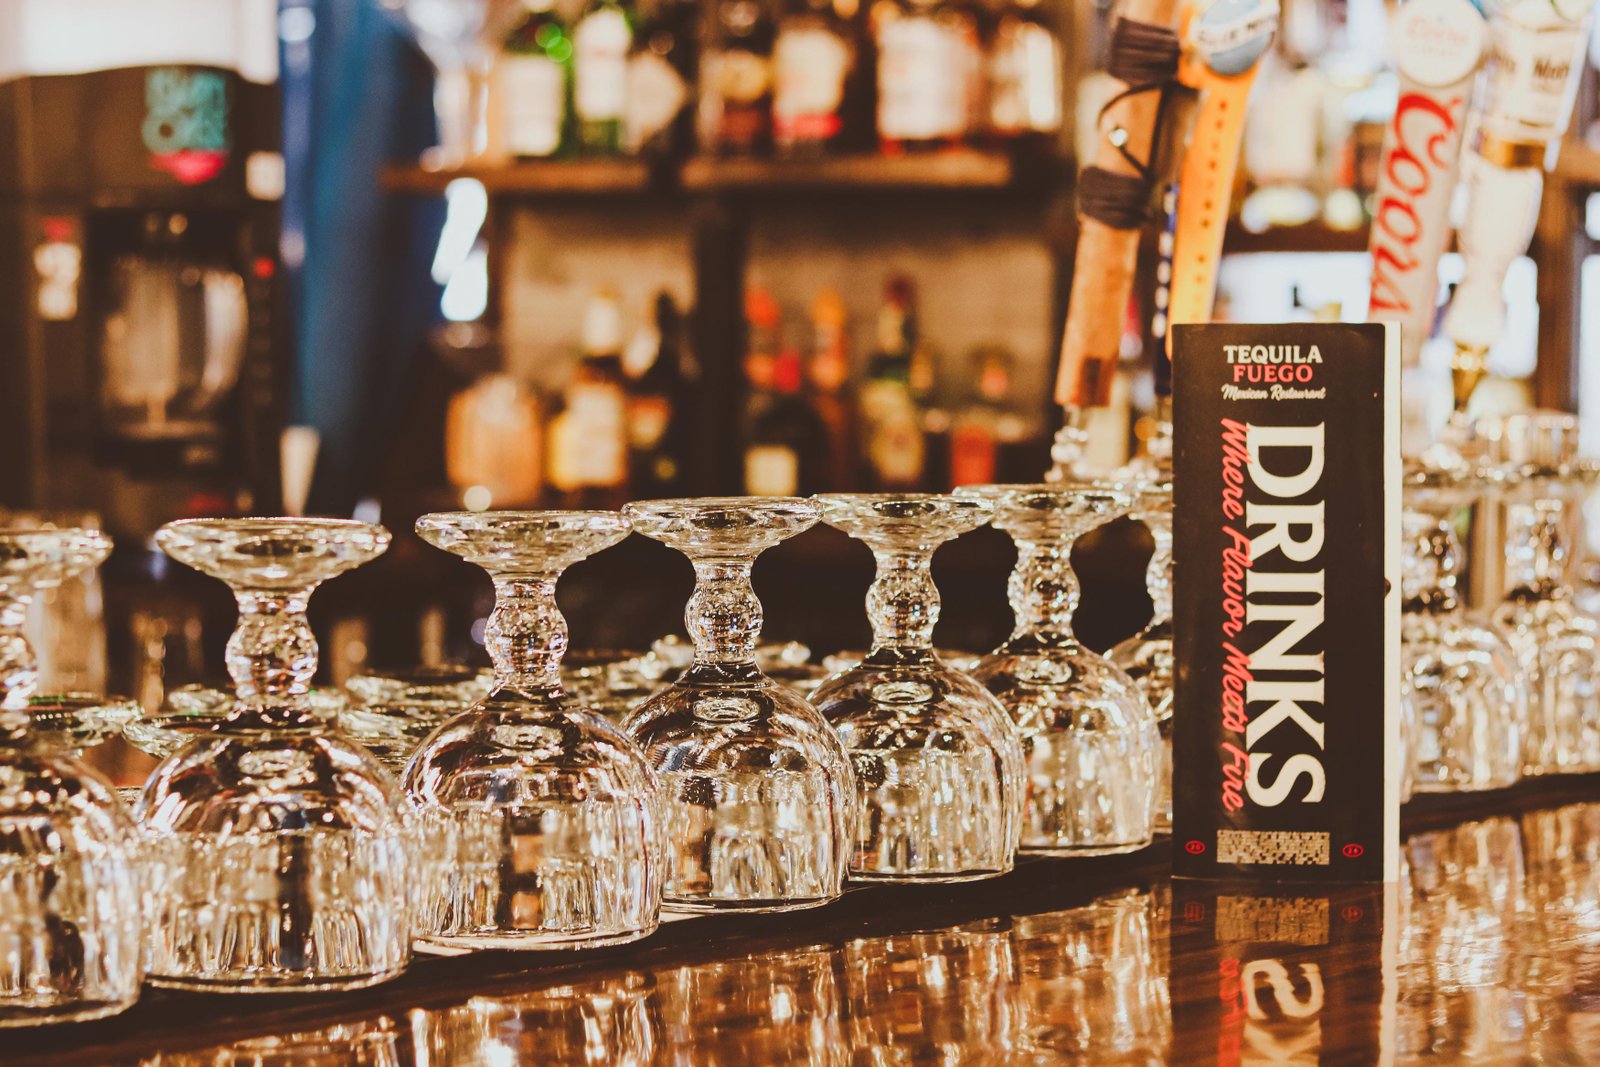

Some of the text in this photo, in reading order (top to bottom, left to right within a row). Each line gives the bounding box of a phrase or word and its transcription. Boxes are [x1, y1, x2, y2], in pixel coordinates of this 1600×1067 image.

[1370, 93, 1463, 313] Coors
[1221, 384, 1326, 401] Mexican Restaurant
[1223, 345, 1323, 364] TEQUILA
[1233, 365, 1313, 383] FUEGO
[1221, 418, 1253, 812] Where Flavor Meets Fire
[1246, 421, 1326, 807] DRINKS
